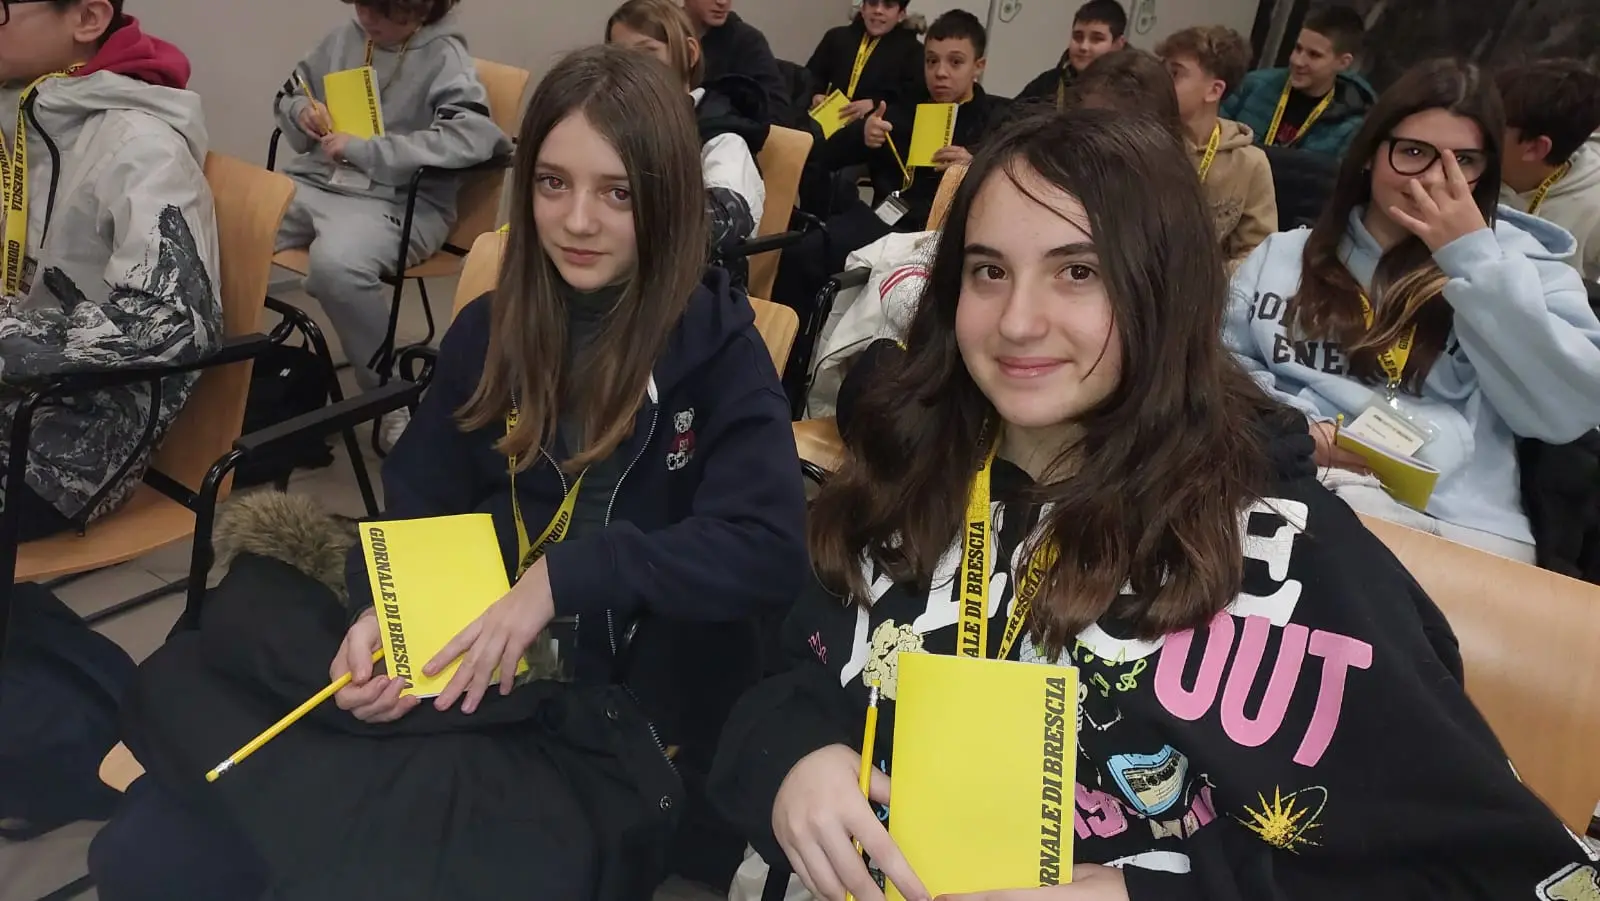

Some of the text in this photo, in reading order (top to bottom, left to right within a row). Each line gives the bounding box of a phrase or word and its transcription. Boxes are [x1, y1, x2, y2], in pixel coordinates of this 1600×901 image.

[12, 165, 24, 211] BRESCIA
[16, 151, 24, 165] DI
[6, 240, 20, 293] GIORNALE
[369, 527, 397, 603] GIORNALE
[384, 602, 400, 621] DI
[966, 521, 986, 597] BRESCIA
[965, 600, 983, 624] DI
[1006, 567, 1046, 641] BRESCIA
[1154, 609, 1373, 768] OUT
[1039, 677, 1067, 888] RNALE DI BRESCIA
